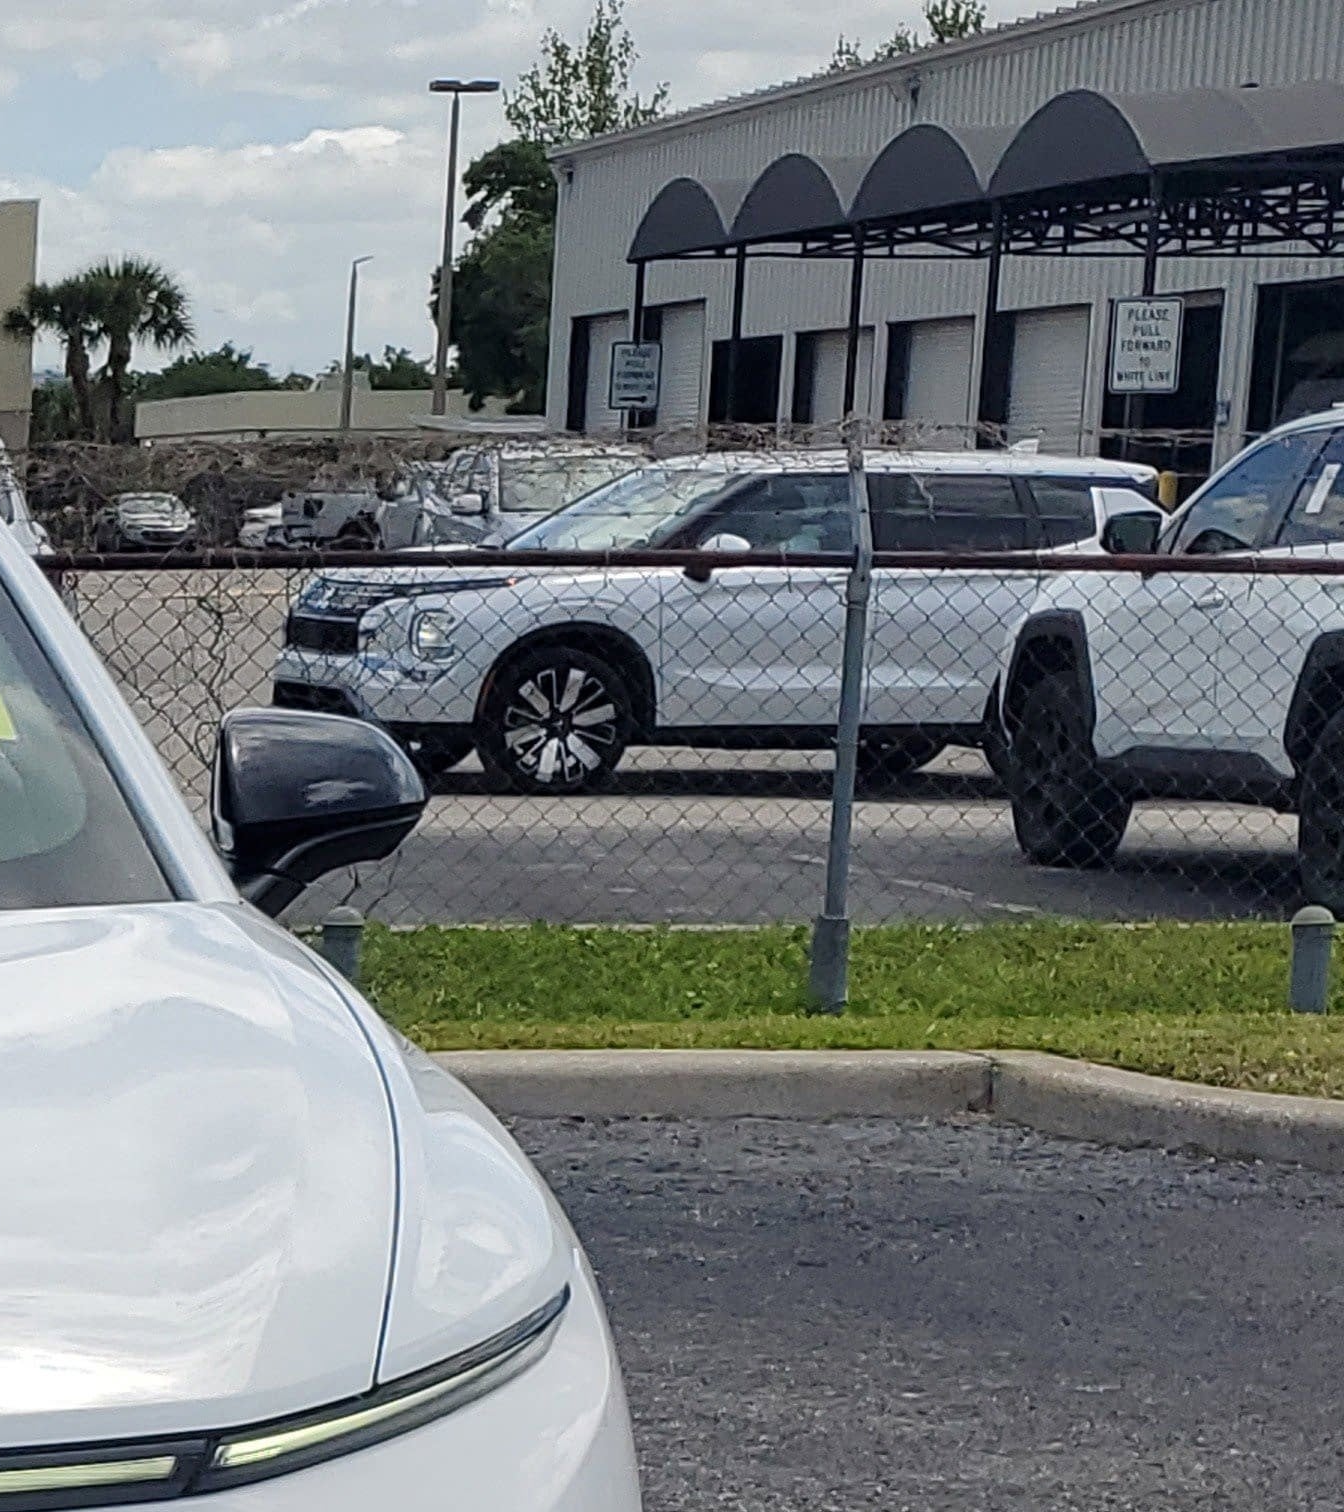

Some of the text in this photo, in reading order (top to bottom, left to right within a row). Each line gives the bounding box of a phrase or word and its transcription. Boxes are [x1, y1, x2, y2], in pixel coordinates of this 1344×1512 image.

[1127, 308, 1171, 321] PLEASE
[1133, 324, 1160, 337] PULL
[1120, 340, 1172, 351] FORWARD
